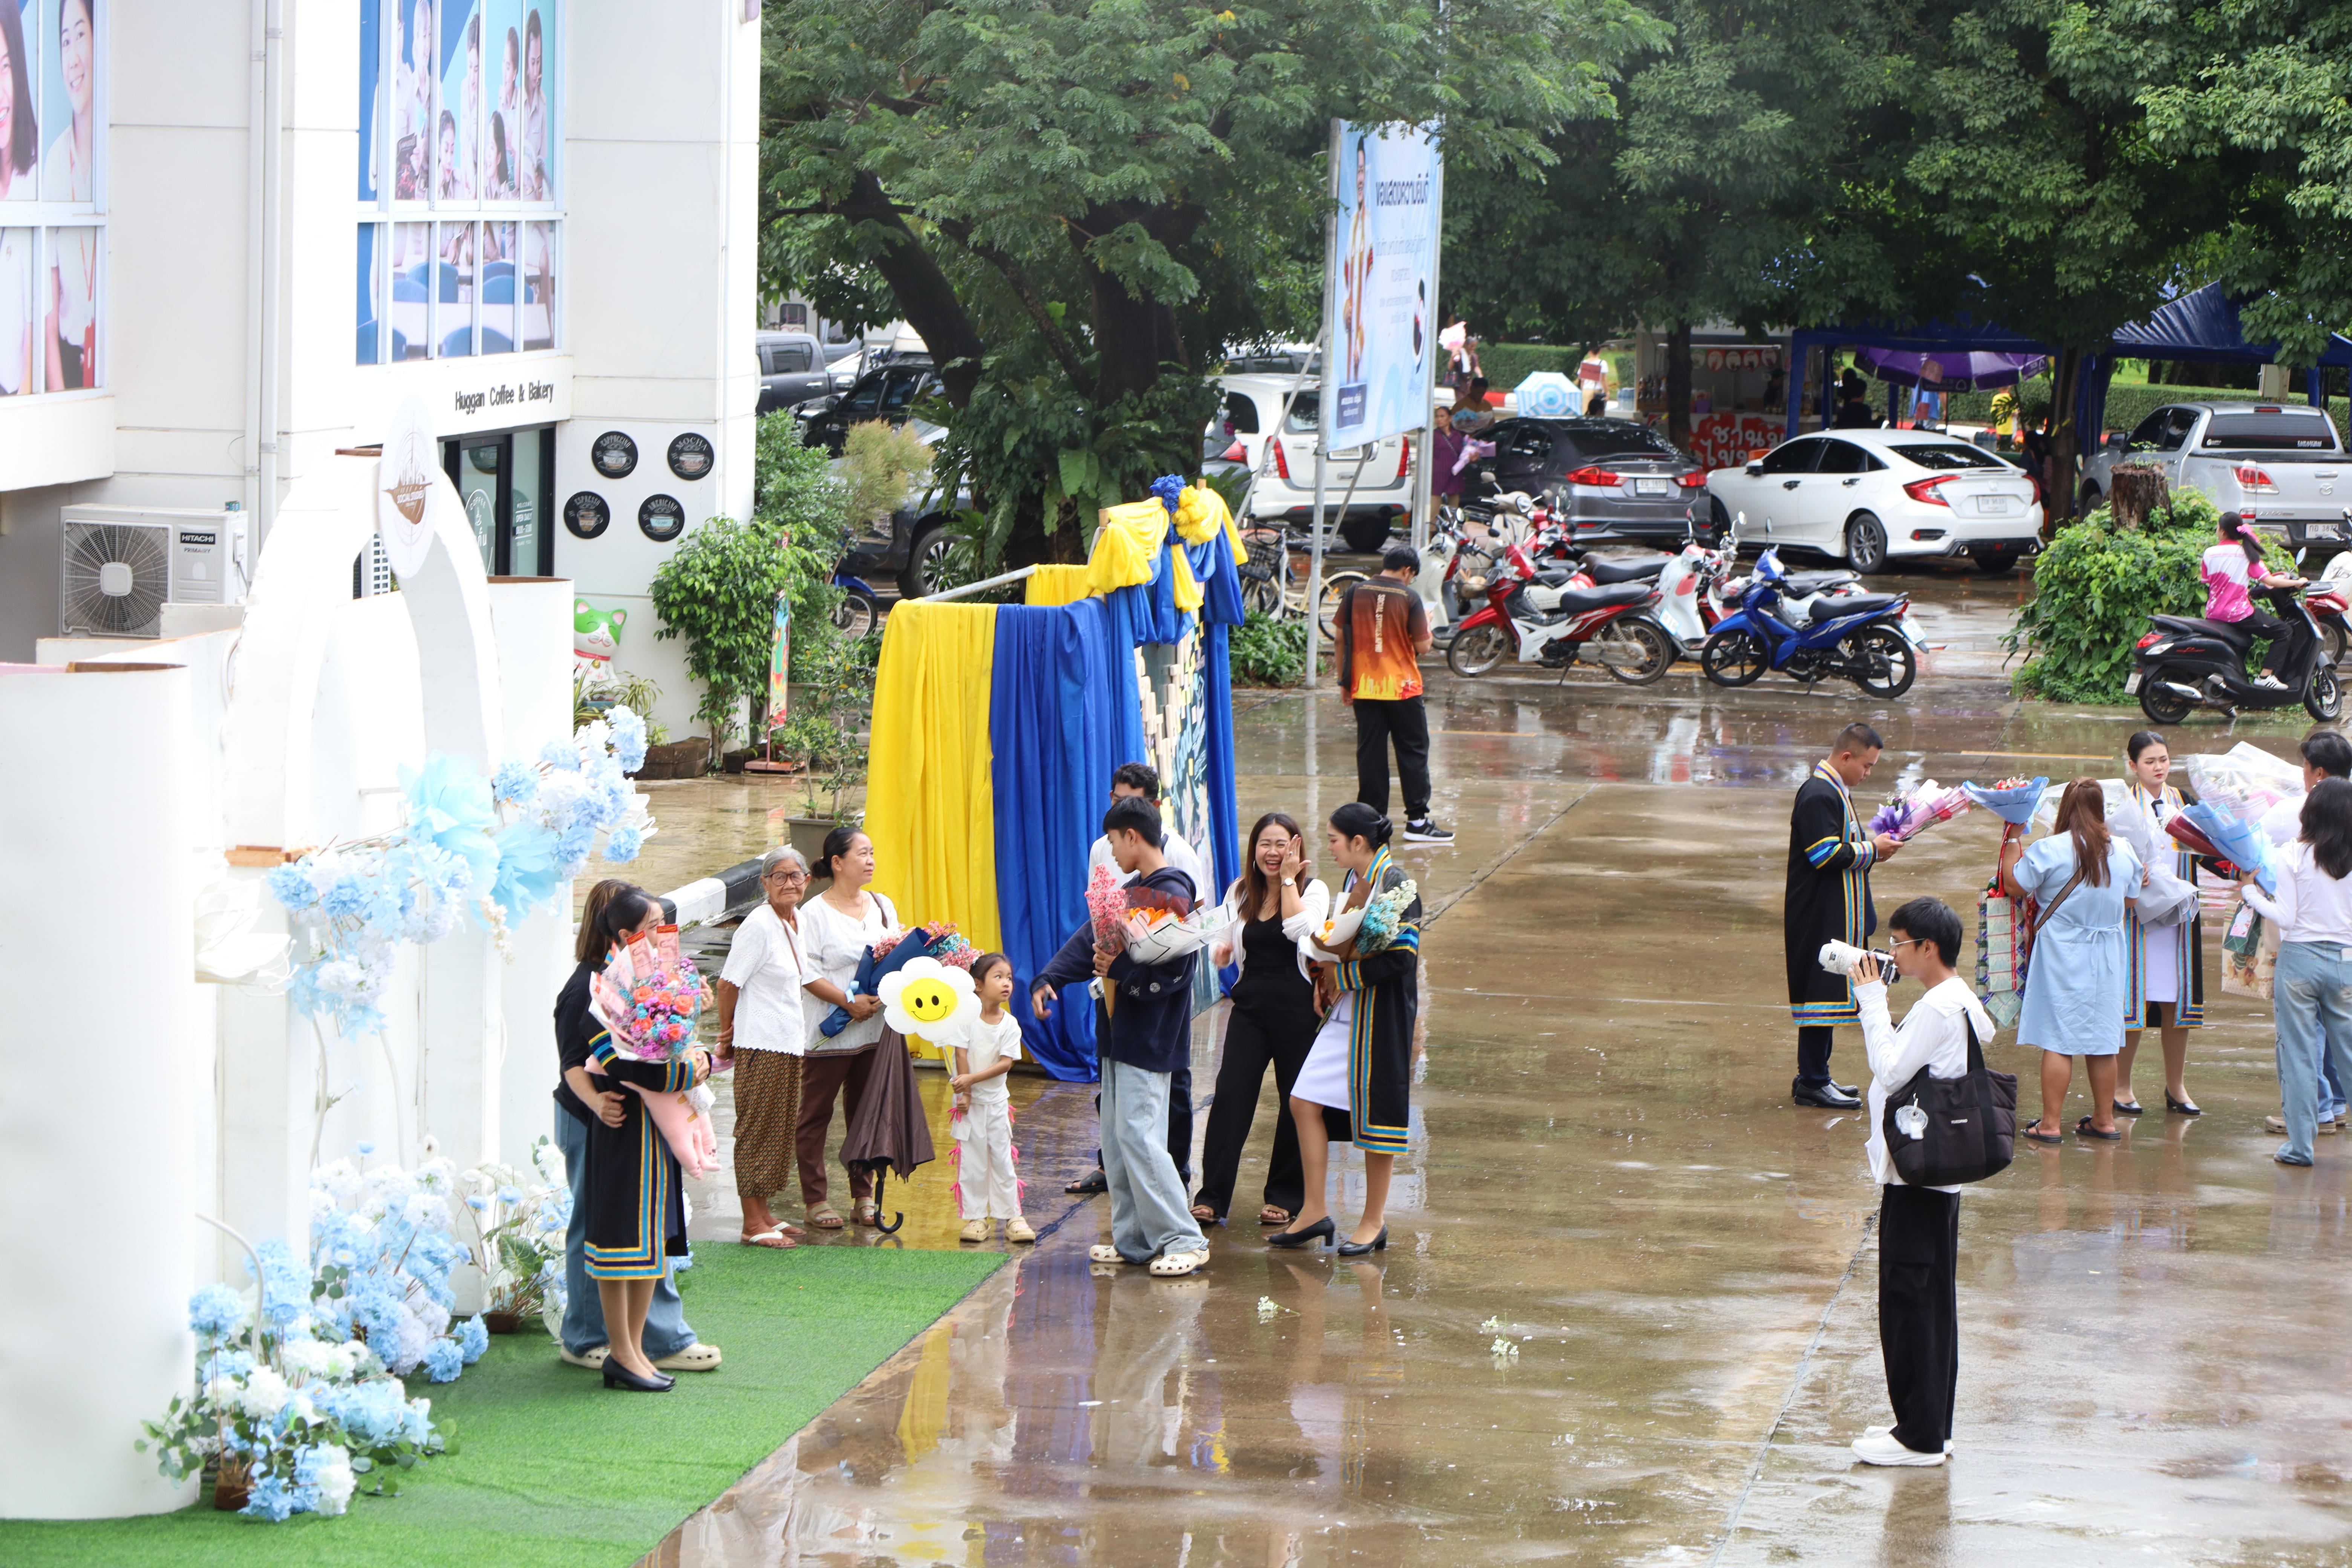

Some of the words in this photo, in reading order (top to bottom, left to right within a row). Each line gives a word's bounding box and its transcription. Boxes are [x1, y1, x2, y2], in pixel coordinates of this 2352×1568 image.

[455, 390, 485, 415] Huggan
[490, 384, 514, 406] Coffee
[519, 383, 524, 403] &
[529, 380, 553, 403] Bakery
[675, 437, 707, 451] MOCHA
[182, 534, 214, 543] HITACHI
[1376, 594, 1386, 614] SOCIAL
